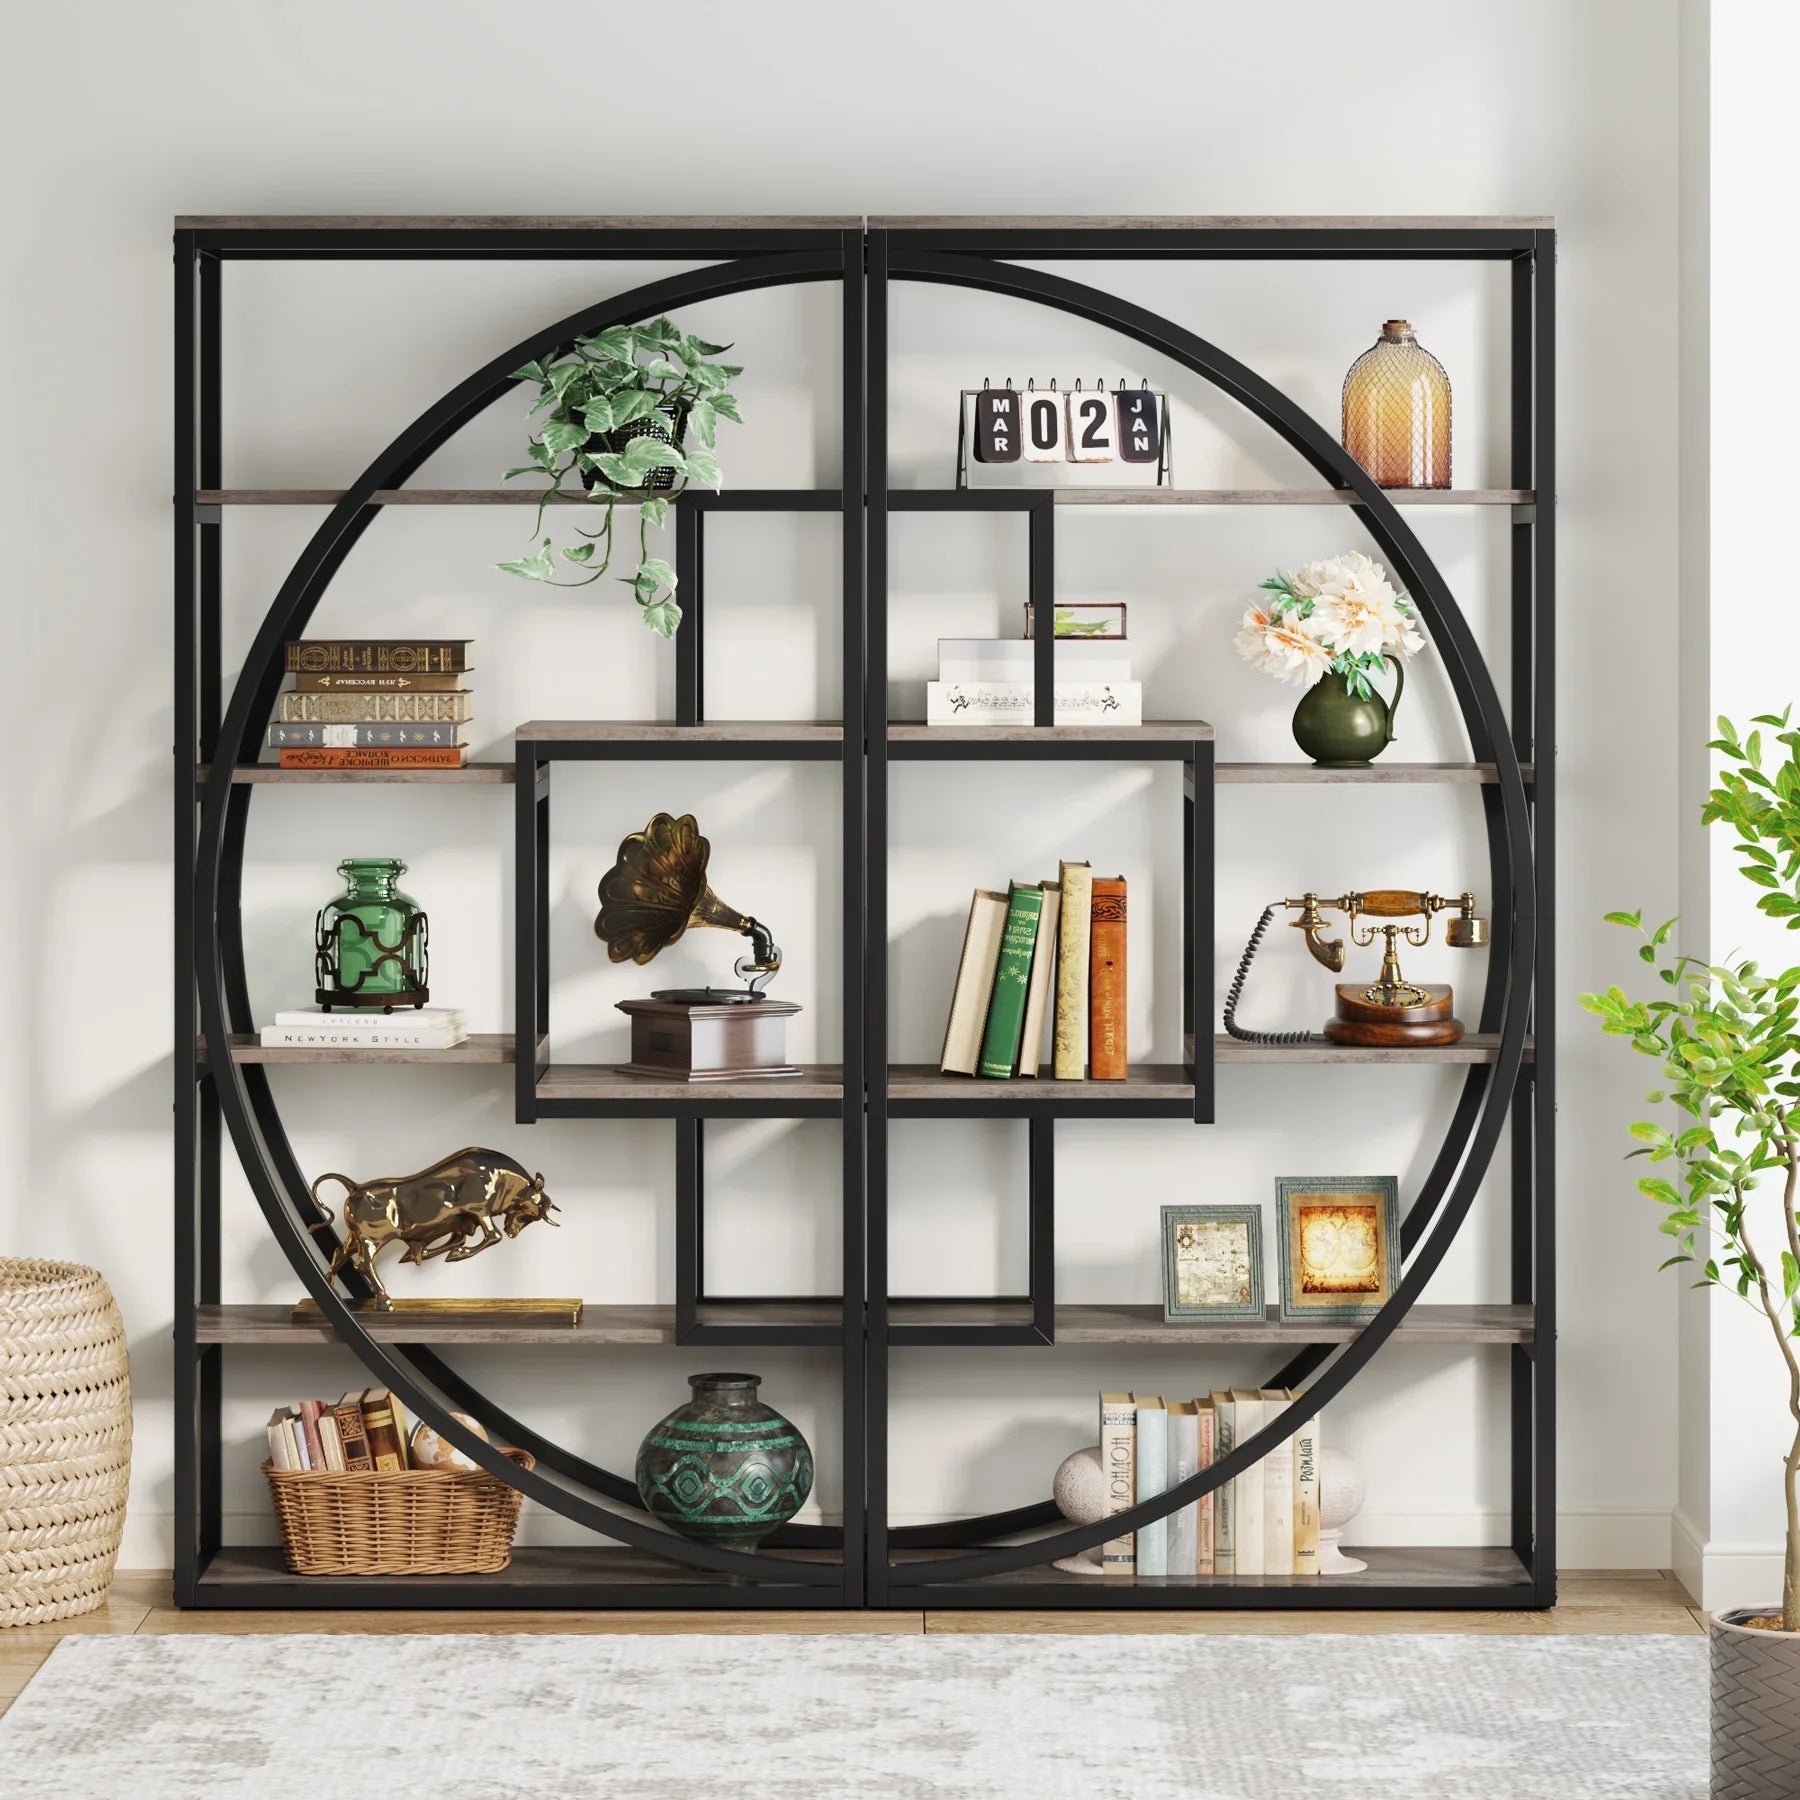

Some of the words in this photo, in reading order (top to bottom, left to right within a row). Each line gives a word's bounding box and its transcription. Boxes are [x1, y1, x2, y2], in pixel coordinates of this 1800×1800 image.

[992, 398, 1010, 452] MAR
[1130, 398, 1150, 452] JAN
[335, 678, 376, 686] БУССЕНАР
[378, 678, 396, 686] ЛУИ
[345, 750, 390, 758] ХОЛМСЕ
[339, 758, 390, 766] ШЕРЛОКЕ
[400, 755, 453, 763] ЗАПИСКИ
[371, 1035, 421, 1043] STYLE
[1110, 1437, 1131, 1503] ЛОНДОН
